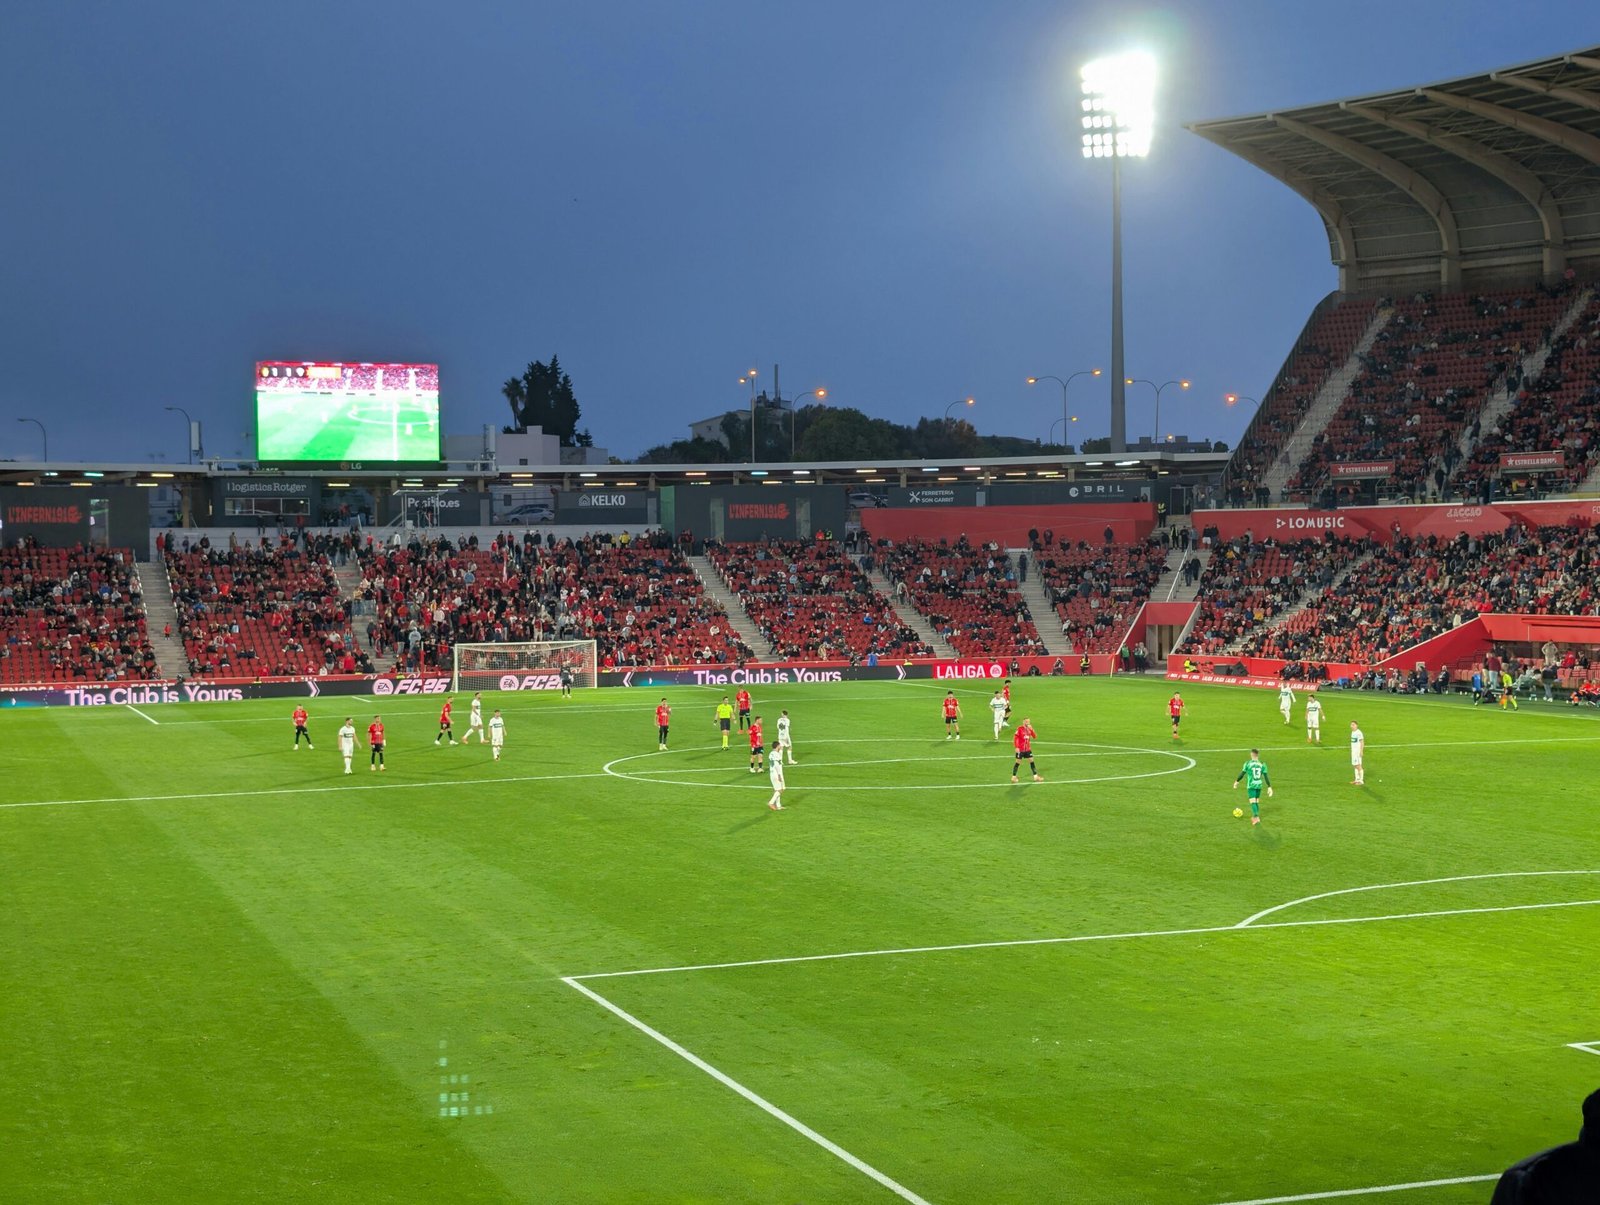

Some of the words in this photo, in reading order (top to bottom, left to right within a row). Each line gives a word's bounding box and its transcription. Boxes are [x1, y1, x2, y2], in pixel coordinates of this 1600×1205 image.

[1084, 484, 1124, 493] BRIL
[591, 494, 626, 506] KELKO
[1289, 516, 1345, 529] LOMUSIC
[693, 669, 728, 685] The
[731, 668, 772, 685] Club
[774, 667, 789, 684] is
[793, 667, 842, 683] Yours
[936, 665, 986, 679] LALIGA
[376, 682, 390, 690] EA
[64, 689, 107, 706] The
[110, 687, 160, 705] Club
[161, 686, 180, 703] is
[184, 685, 243, 702] Yours
[1251, 767, 1262, 780] 13
